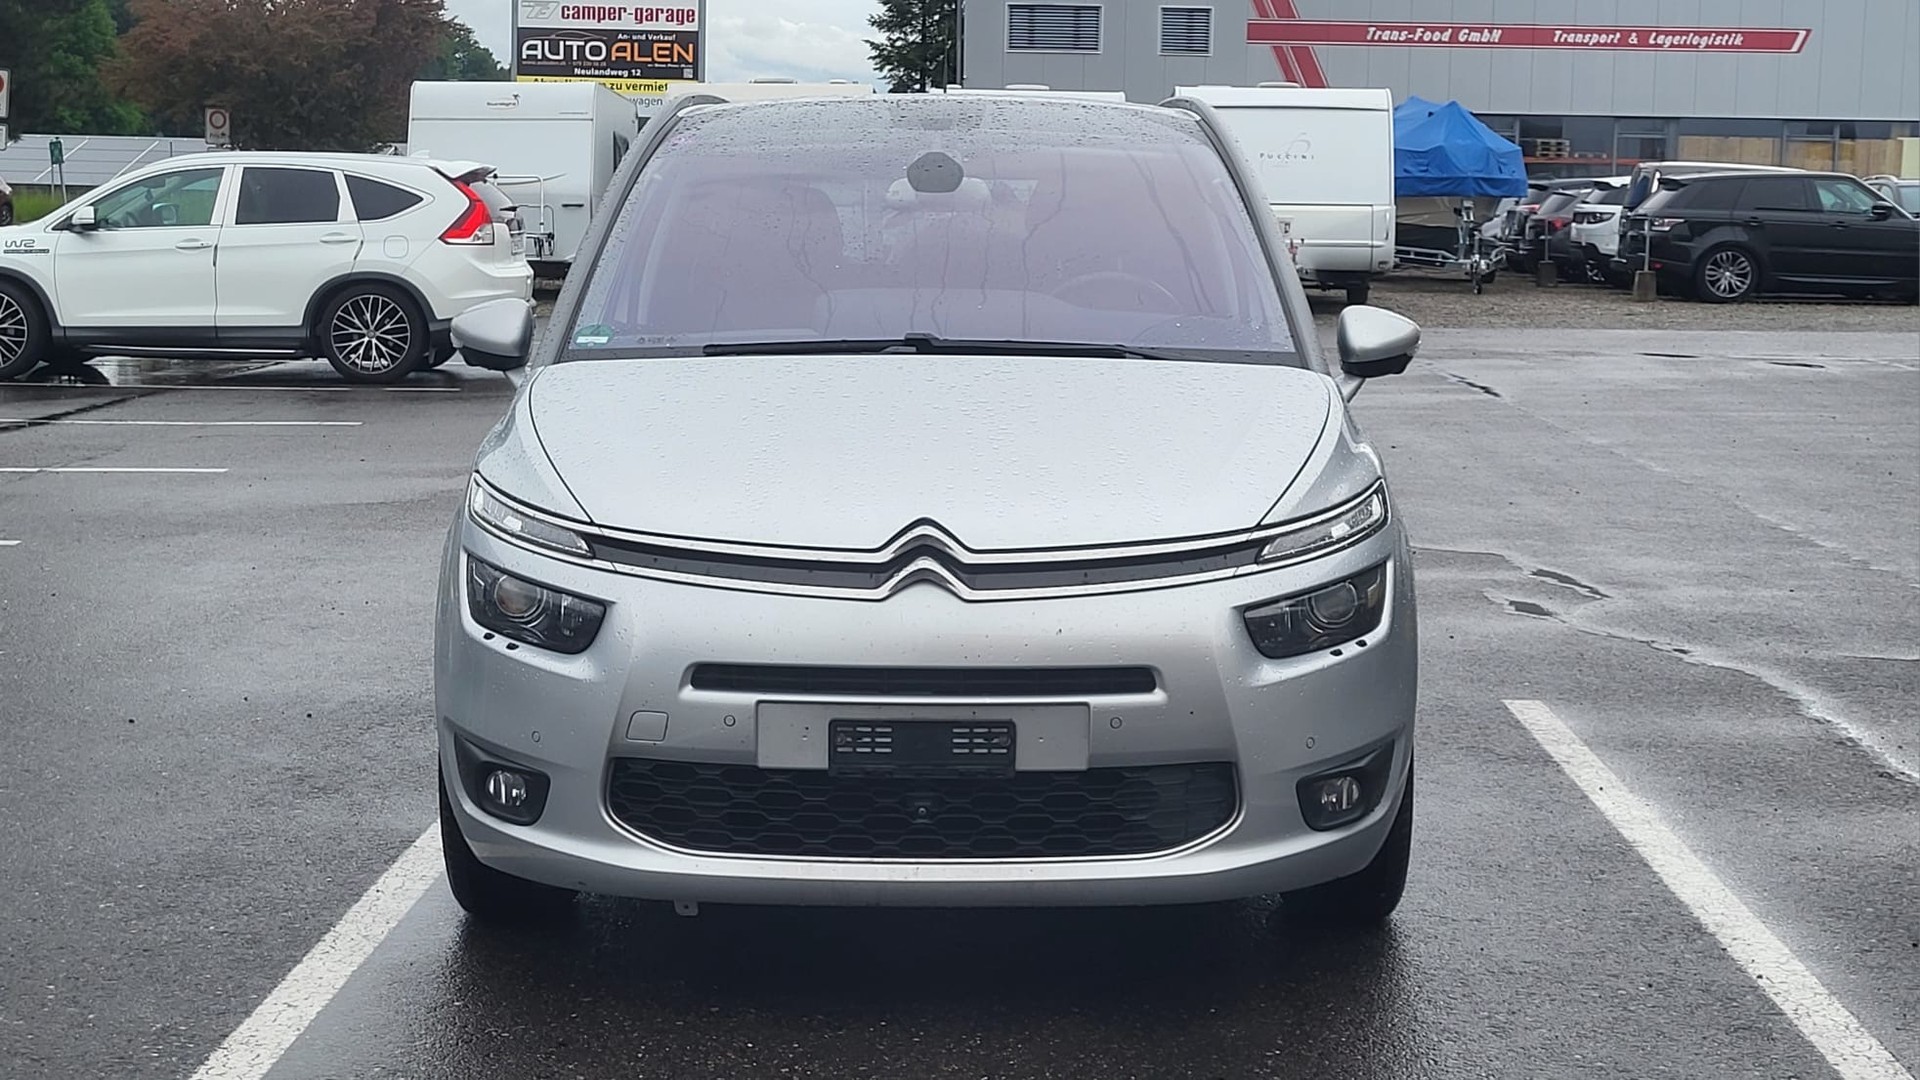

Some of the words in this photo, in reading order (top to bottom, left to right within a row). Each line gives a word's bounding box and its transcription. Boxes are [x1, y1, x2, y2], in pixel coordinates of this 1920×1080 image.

[561, 5, 695, 25] camper-garage
[1366, 27, 1452, 41] Trans-Food
[1458, 28, 1502, 42] GmbH
[1553, 30, 1621, 46] Transport
[1628, 33, 1639, 44] &
[1649, 32, 1744, 48] Lagerlogistik
[522, 40, 607, 61] AUTO
[611, 42, 694, 63] ALEN
[574, 68, 629, 77] Neulandweg
[631, 69, 642, 77] 12
[610, 82, 623, 91] zu
